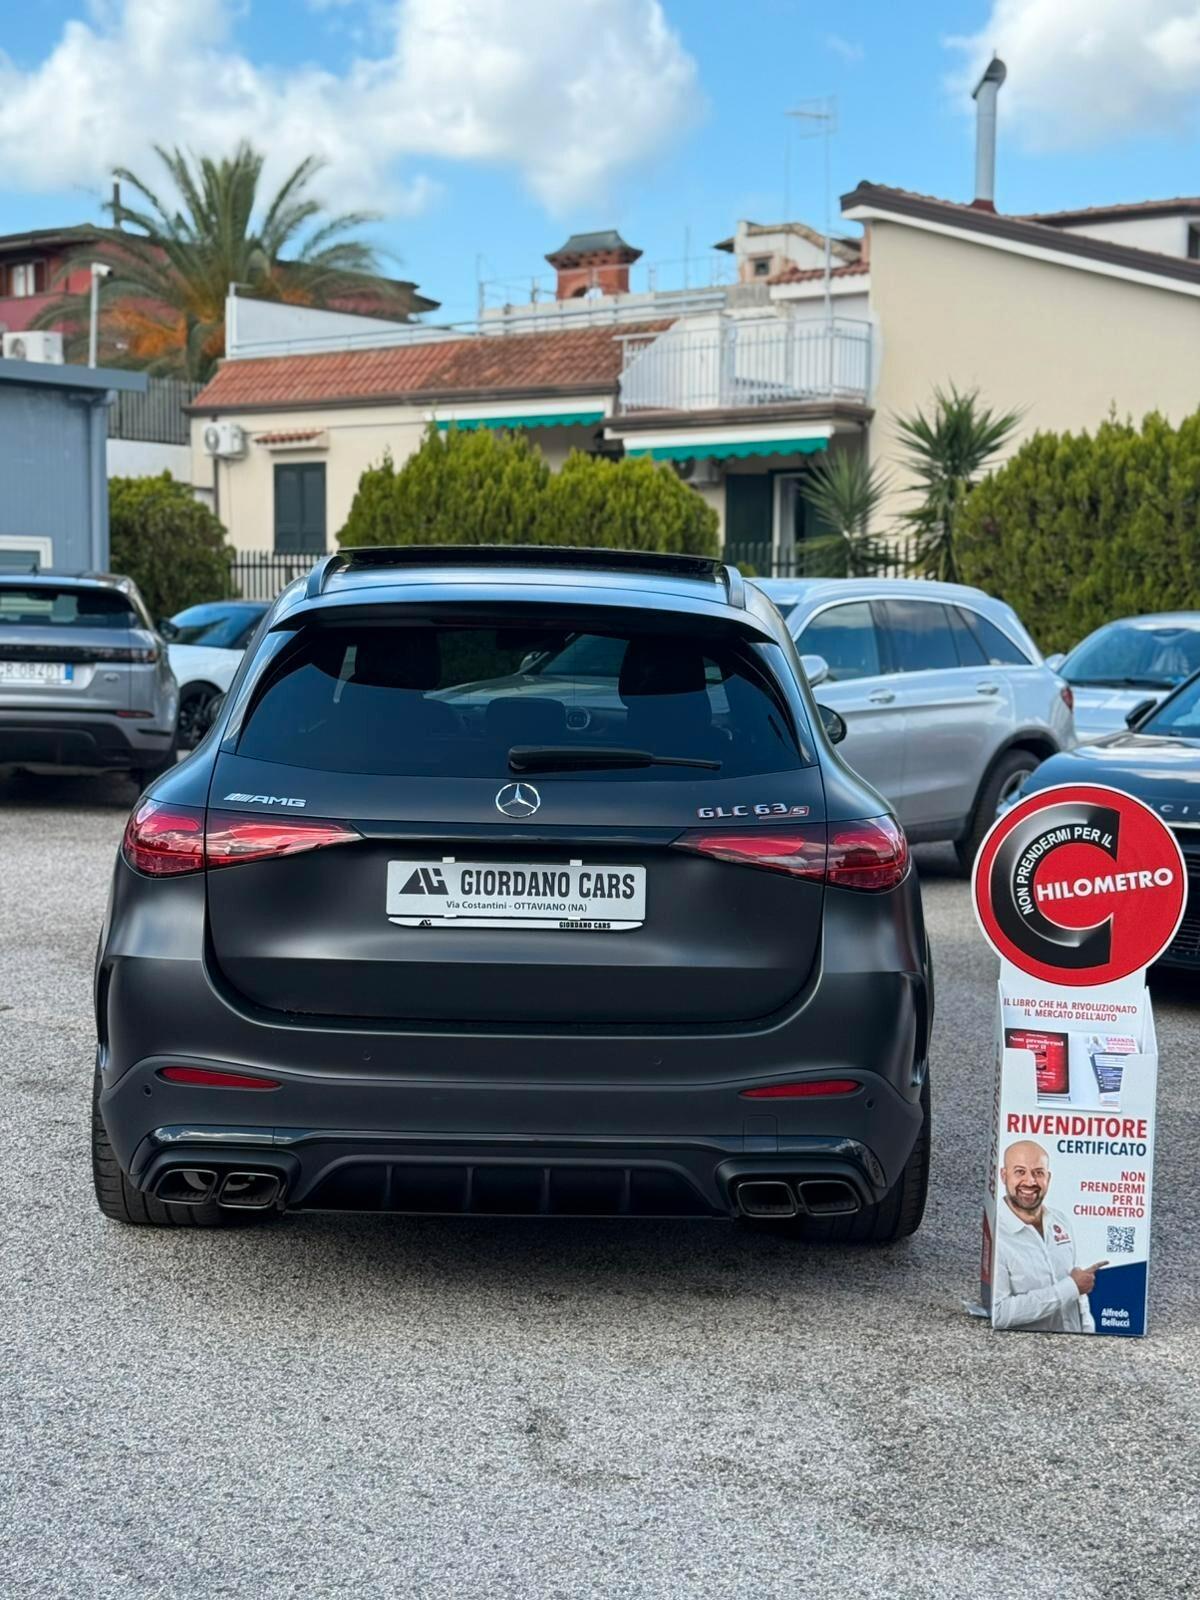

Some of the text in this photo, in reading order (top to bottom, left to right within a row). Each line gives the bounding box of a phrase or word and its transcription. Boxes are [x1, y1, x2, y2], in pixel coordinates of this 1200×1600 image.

[248, 795, 306, 807] AMG
[697, 805, 749, 818] GLC
[753, 803, 788, 815] 63
[1016, 826, 1113, 916] NON PRENDERMI PER IL
[460, 869, 570, 898] GIORDANO
[578, 872, 635, 900] CARS
[1036, 867, 1174, 902] HILOMETRO
[446, 901, 460, 909] Via
[462, 901, 507, 910] Costantini
[514, 902, 566, 912] OTTAVIANO
[568, 903, 587, 912] (NA)
[559, 921, 592, 929] GIORDANO
[1003, 998, 1137, 1014] IL LIBRO CHE HA RIVOLUZIONATO
[1024, 1008, 1118, 1022] IL MERCATO DELL'AUTO
[1007, 1113, 1148, 1139] RIVENDITORE
[1057, 1139, 1147, 1157] CERTIFICATO
[1121, 1171, 1146, 1182] NON
[1080, 1181, 1146, 1194] PRENDERMI
[1112, 1194, 1145, 1206] PER IL
[1073, 1204, 1145, 1218] CHILOMETRO
[1101, 1307, 1130, 1318] Alfredo
[1101, 1317, 1131, 1328] Bellucci
